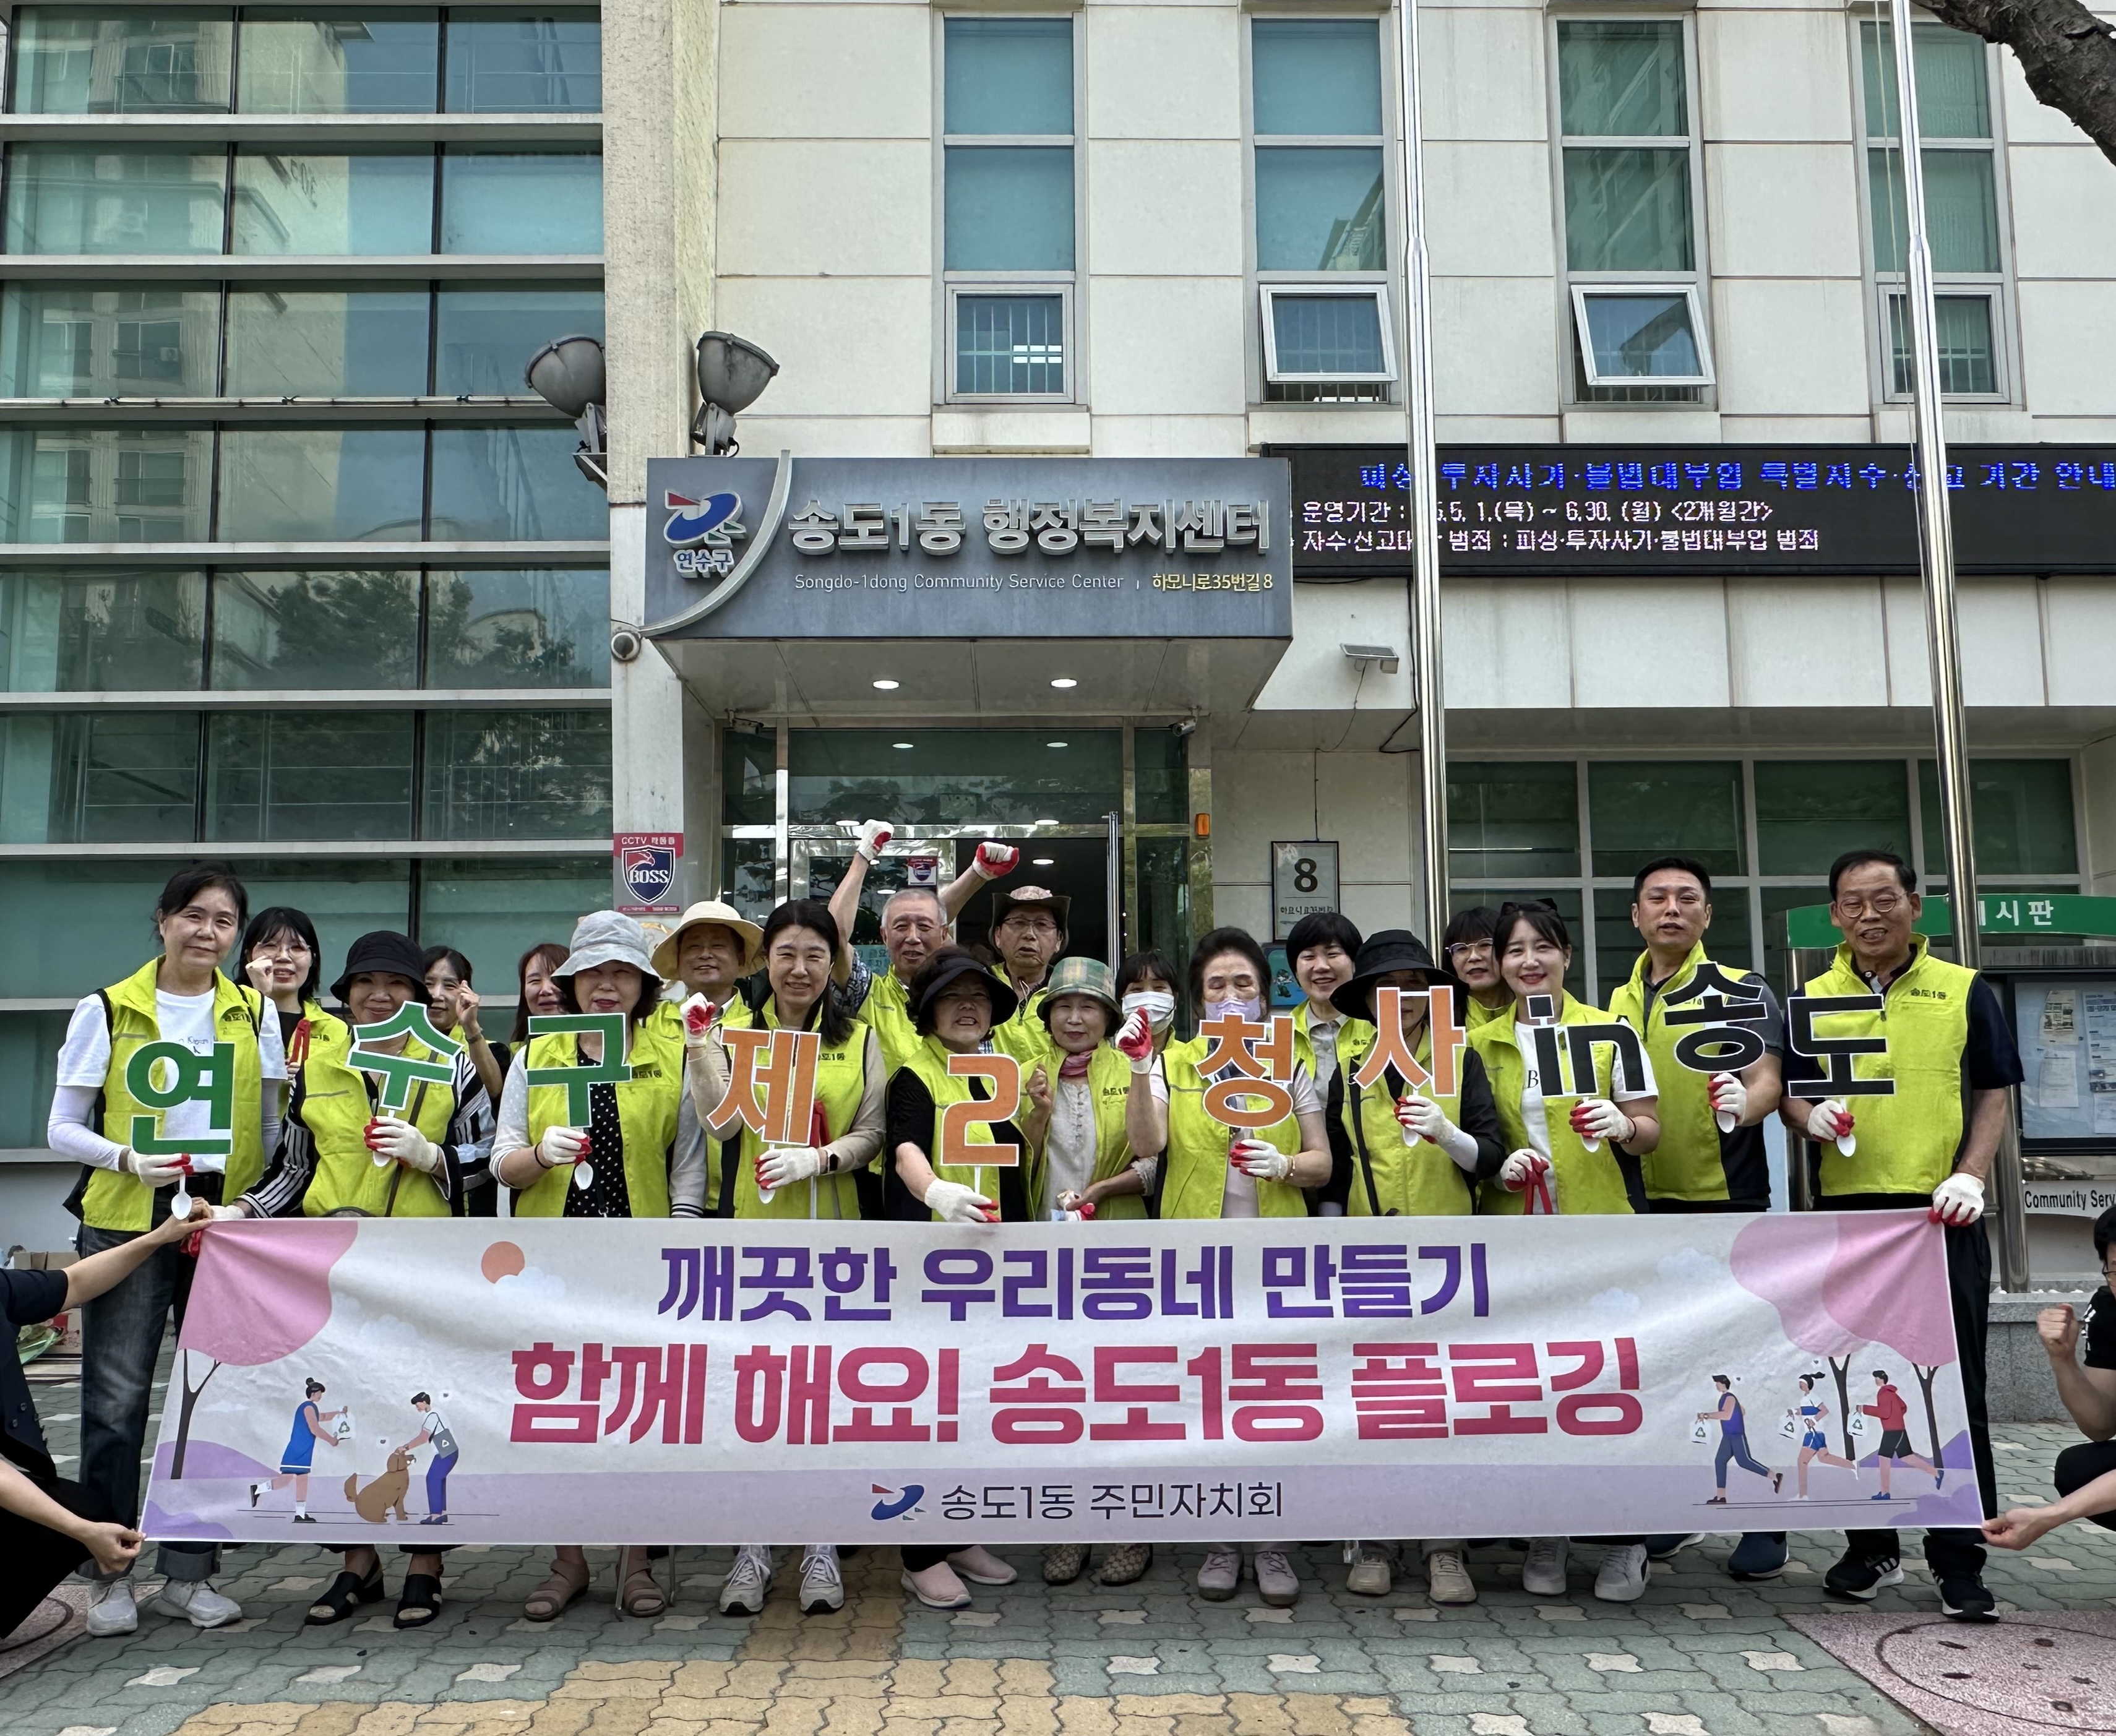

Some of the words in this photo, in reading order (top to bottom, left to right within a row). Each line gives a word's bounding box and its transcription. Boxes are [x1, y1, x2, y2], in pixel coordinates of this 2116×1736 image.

[1980, 463, 2040, 490] 기간
[2054, 463, 2116, 490] 안내
[1302, 501, 1391, 523] 운영기간
[1566, 501, 1611, 522] 6.30.
[1621, 501, 1661, 522] (월)
[1671, 501, 1773, 522] <2개월간>
[788, 500, 966, 556] 송도1동
[983, 499, 1269, 556] 행정복지센터
[1449, 530, 1491, 551] 범죄
[1777, 529, 1818, 551] 범죄
[674, 549, 734, 573] 연수구
[795, 574, 908, 592] Songdo-1dong
[914, 574, 1003, 592] Community
[1009, 573, 1065, 588] Service
[1072, 574, 1124, 588] Center
[1152, 573, 1261, 592] 하모니로35번길
[1263, 574, 1273, 589] 8
[621, 836, 647, 845] CCTV
[629, 869, 669, 883] BOSS
[1294, 857, 1318, 893] 8
[2024, 1190, 2086, 1210] Community
[2091, 1190, 2116, 1208] Serv
[658, 1246, 897, 1321] 깨끗한
[921, 1245, 1233, 1321] 우리동네
[1262, 1243, 1489, 1319] 만들기
[510, 1342, 708, 1444] 함께
[734, 1345, 960, 1445] 해요!
[989, 1343, 1324, 1445] 송도1동
[1351, 1337, 1643, 1440] 플로깅
[941, 1485, 1075, 1520] 송도1동
[1090, 1482, 1283, 1520] 주민자치회
